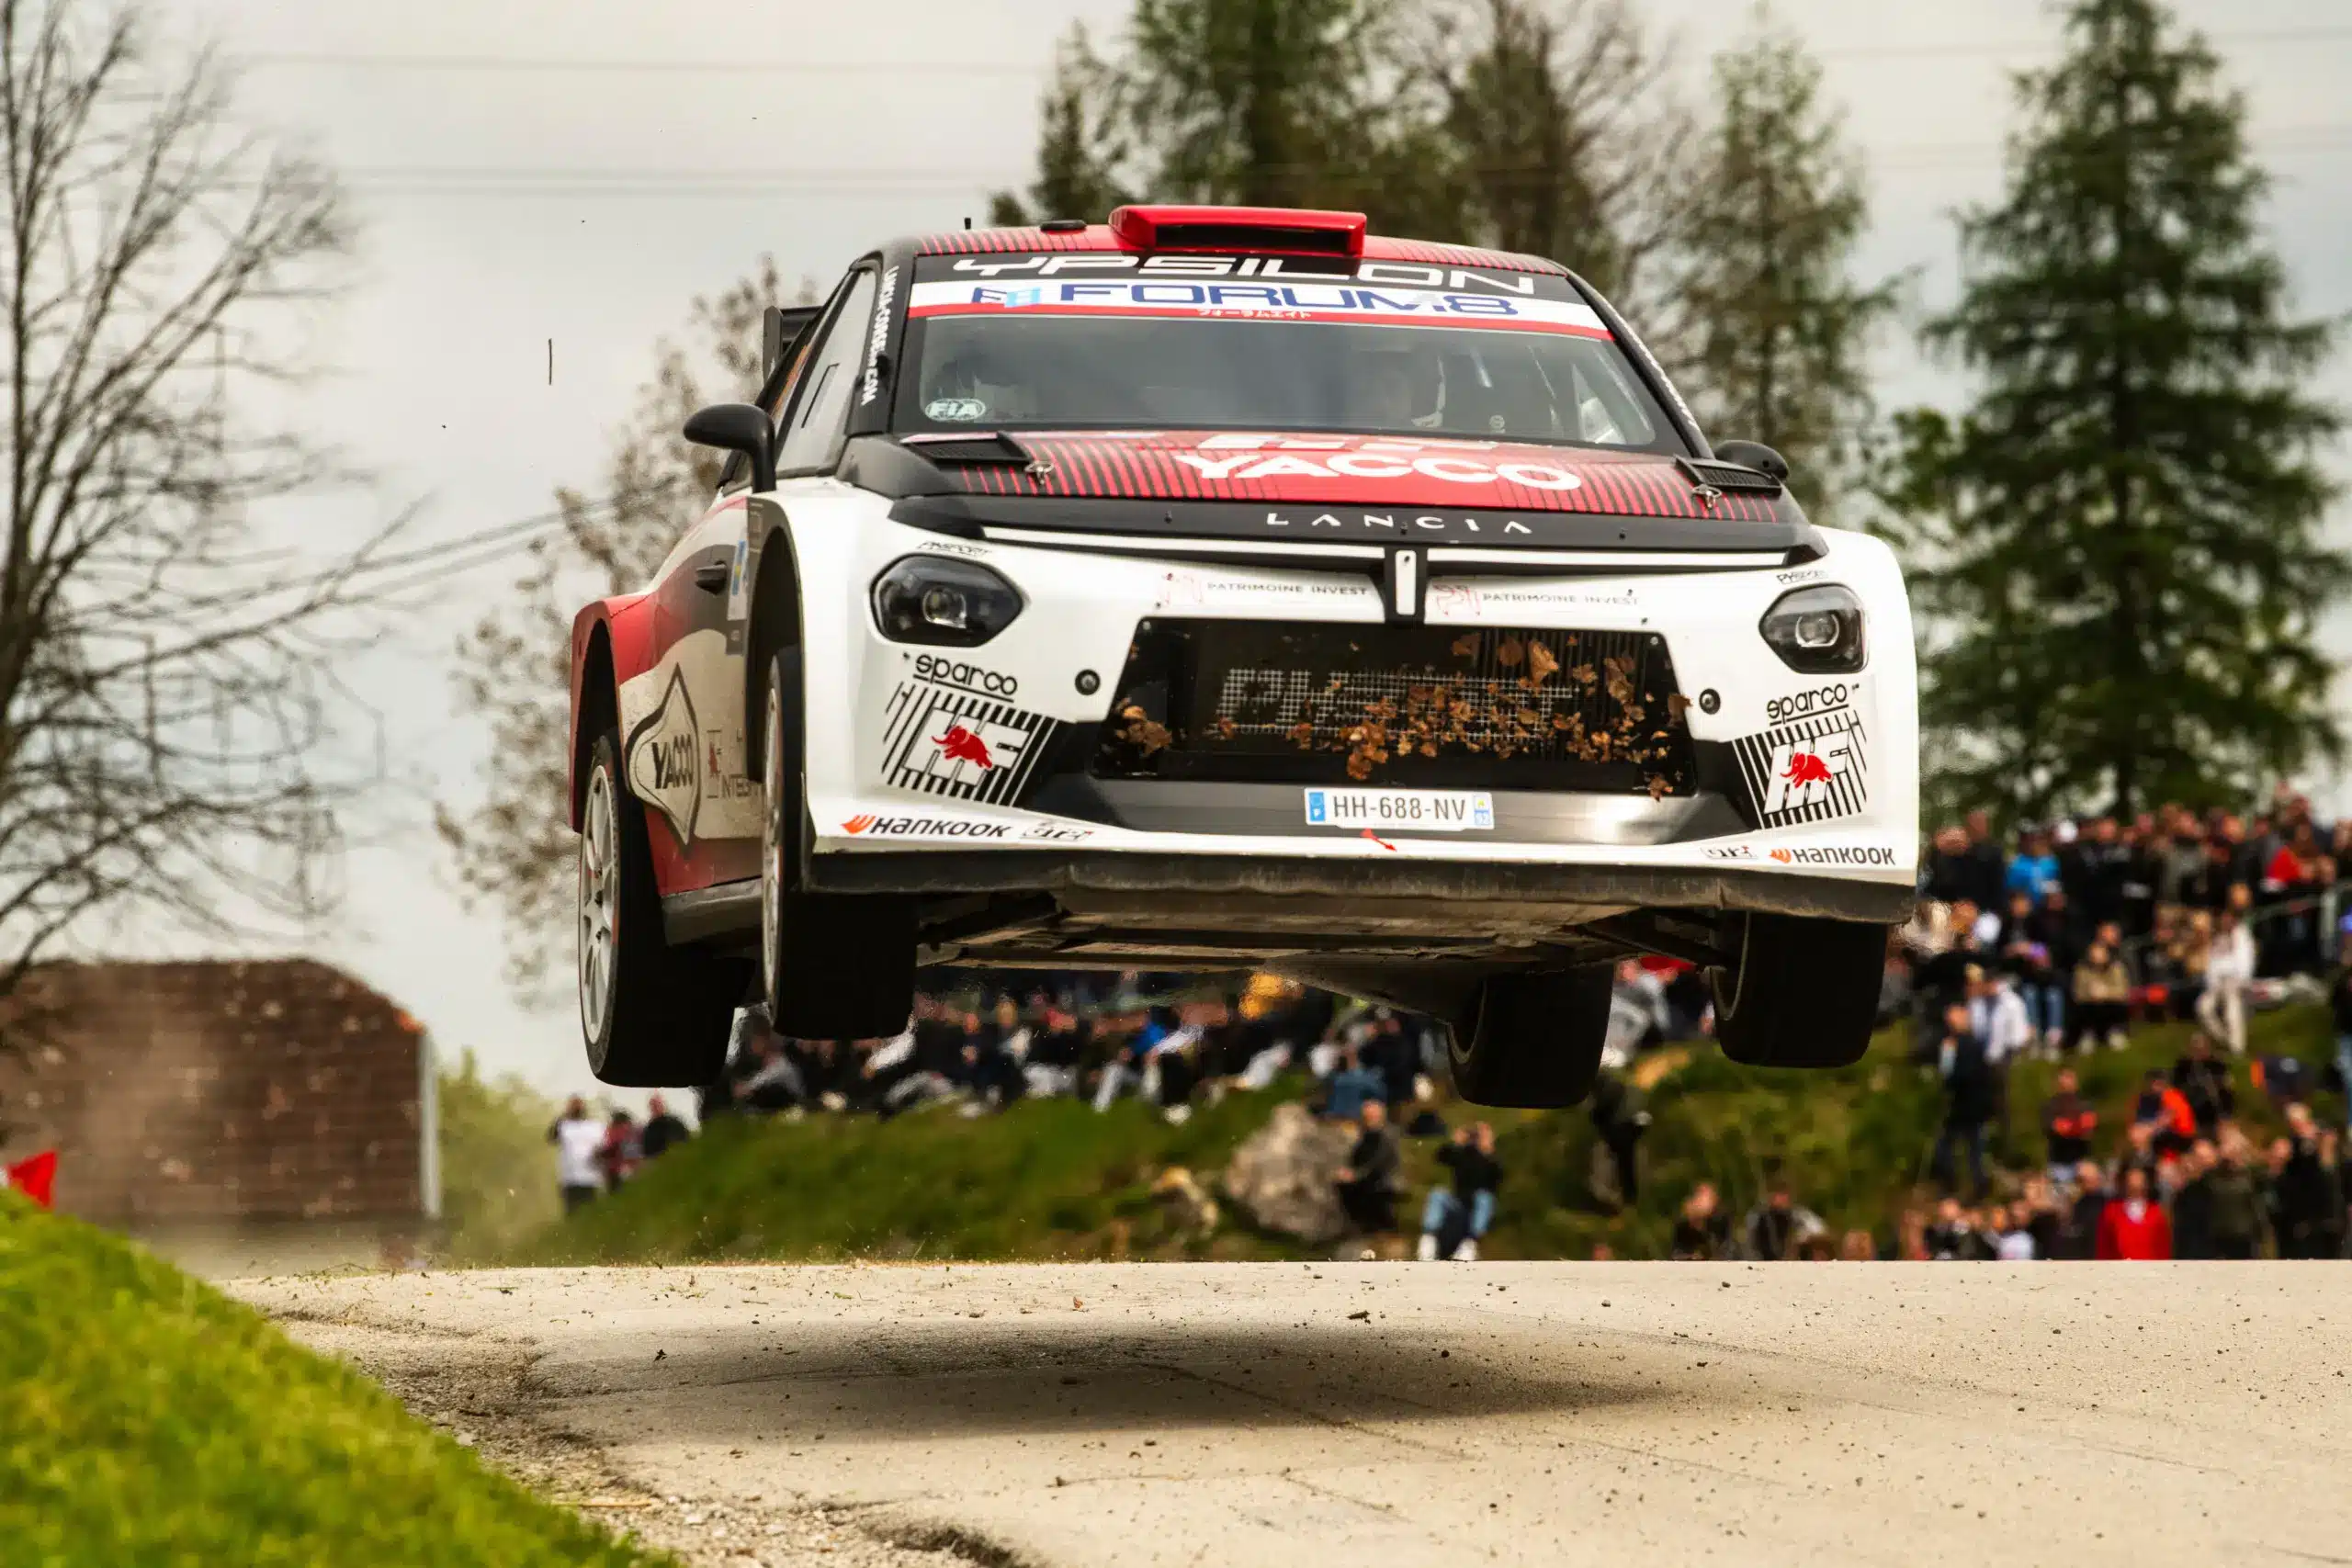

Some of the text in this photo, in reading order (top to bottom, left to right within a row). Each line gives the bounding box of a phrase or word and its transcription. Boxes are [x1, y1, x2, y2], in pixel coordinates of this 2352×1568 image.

[953, 255, 1535, 295] YPSILON
[1060, 283, 1519, 315] FORUM8
[1175, 453, 1581, 491] YACCO
[1266, 512, 1532, 534] LANCIA
[1207, 581, 1368, 595] PATRIMOINE INVEST
[916, 653, 1018, 695] sparco
[1766, 683, 1848, 725] sparco
[1333, 795, 1465, 820] HH-688-NV
